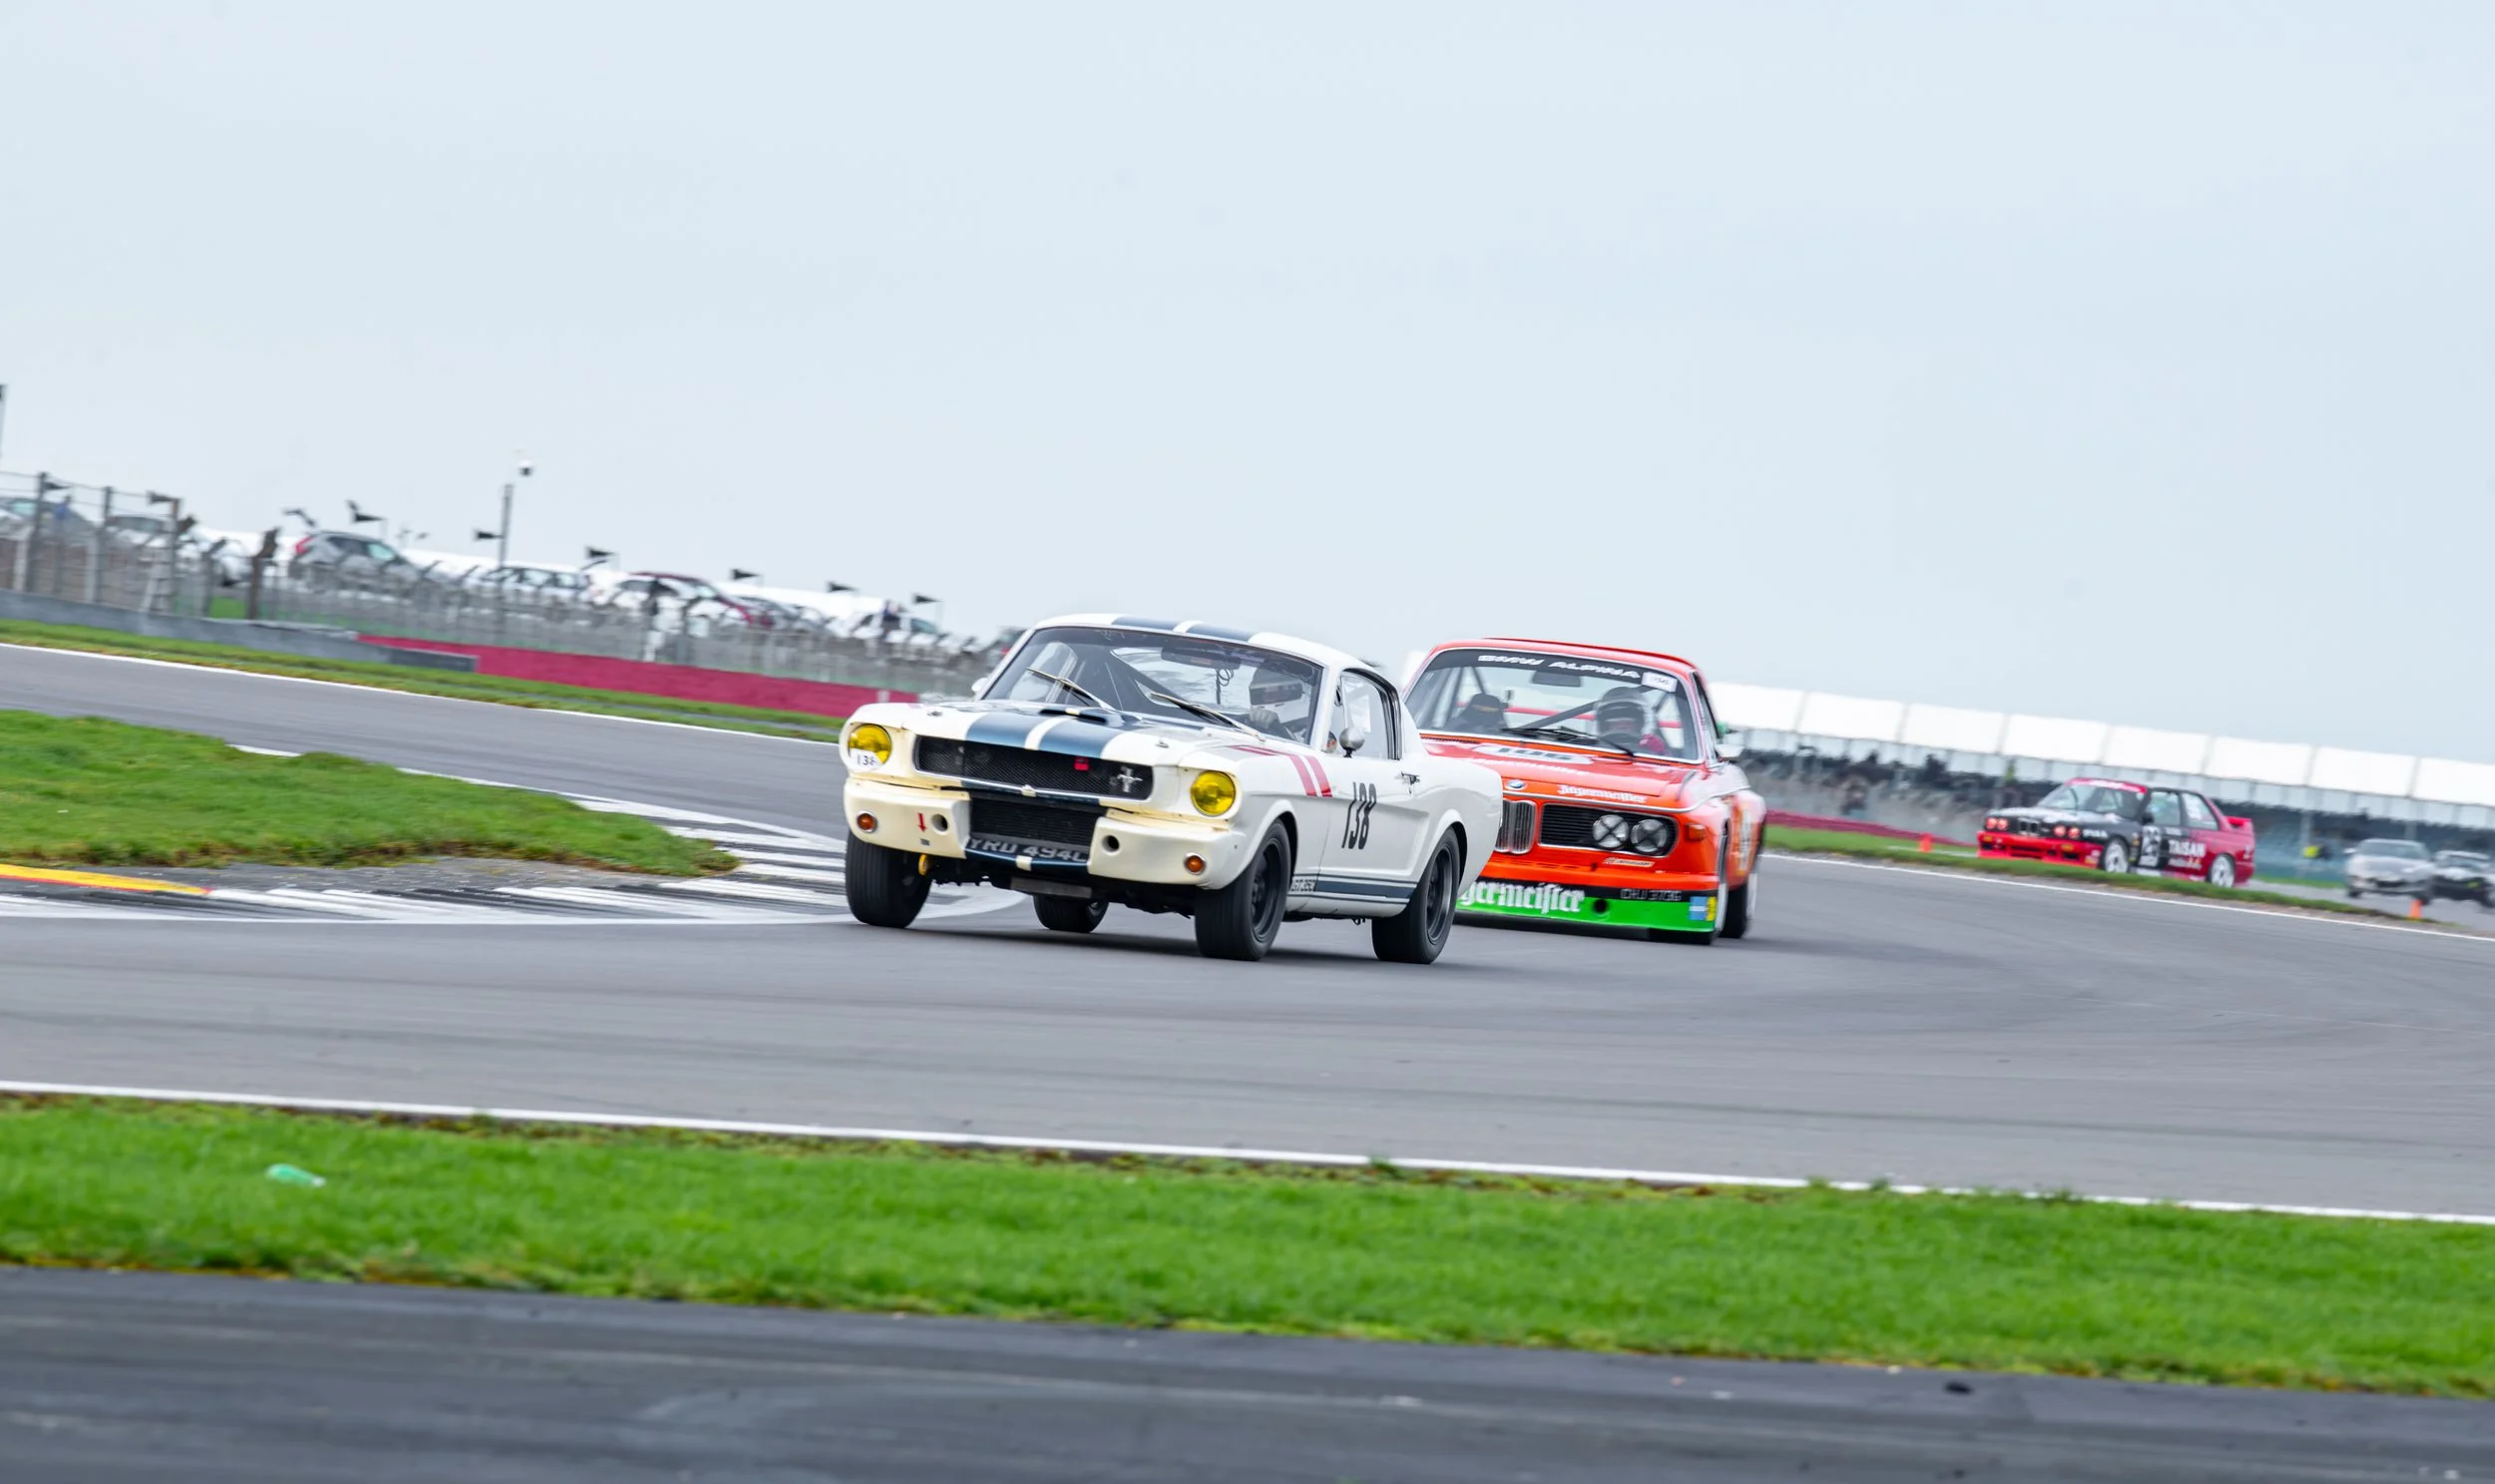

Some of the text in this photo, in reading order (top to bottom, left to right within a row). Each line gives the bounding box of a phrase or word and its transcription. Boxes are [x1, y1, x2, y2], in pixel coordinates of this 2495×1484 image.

[1548, 662, 1642, 679] ALPINA
[1341, 781, 1377, 849] 138
[1460, 881, 1585, 914] germeister
